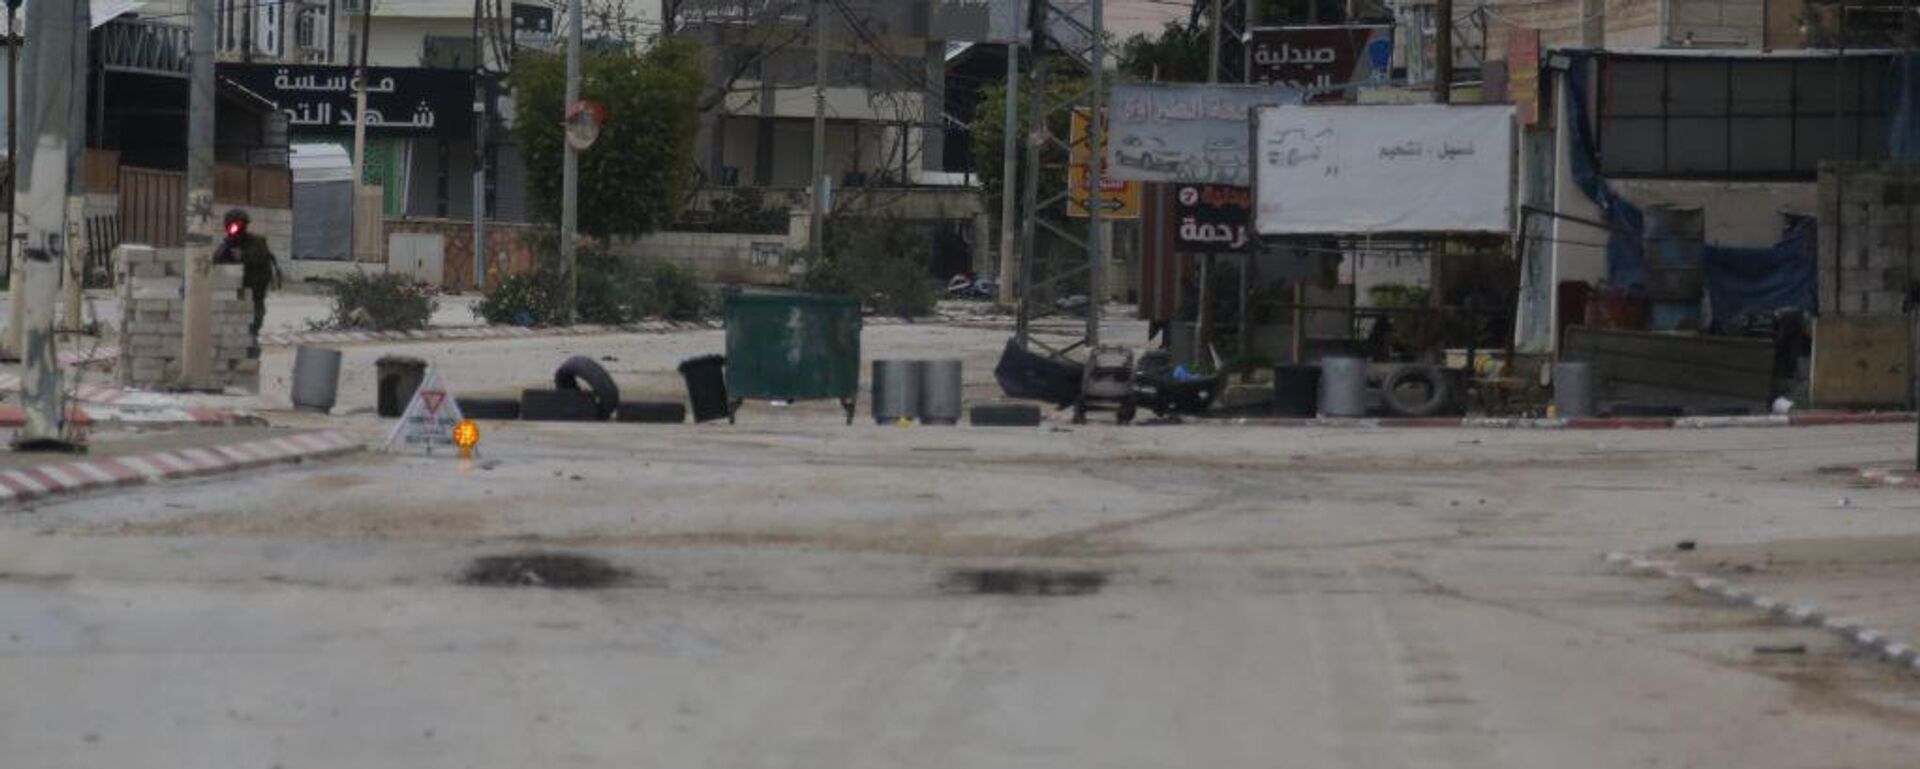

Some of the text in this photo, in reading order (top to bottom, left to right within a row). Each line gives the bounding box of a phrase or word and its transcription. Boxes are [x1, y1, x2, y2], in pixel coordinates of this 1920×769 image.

[1255, 42, 1336, 70] صيدلية
[274, 69, 395, 98] مؤسسة
[339, 100, 435, 127] شهد
